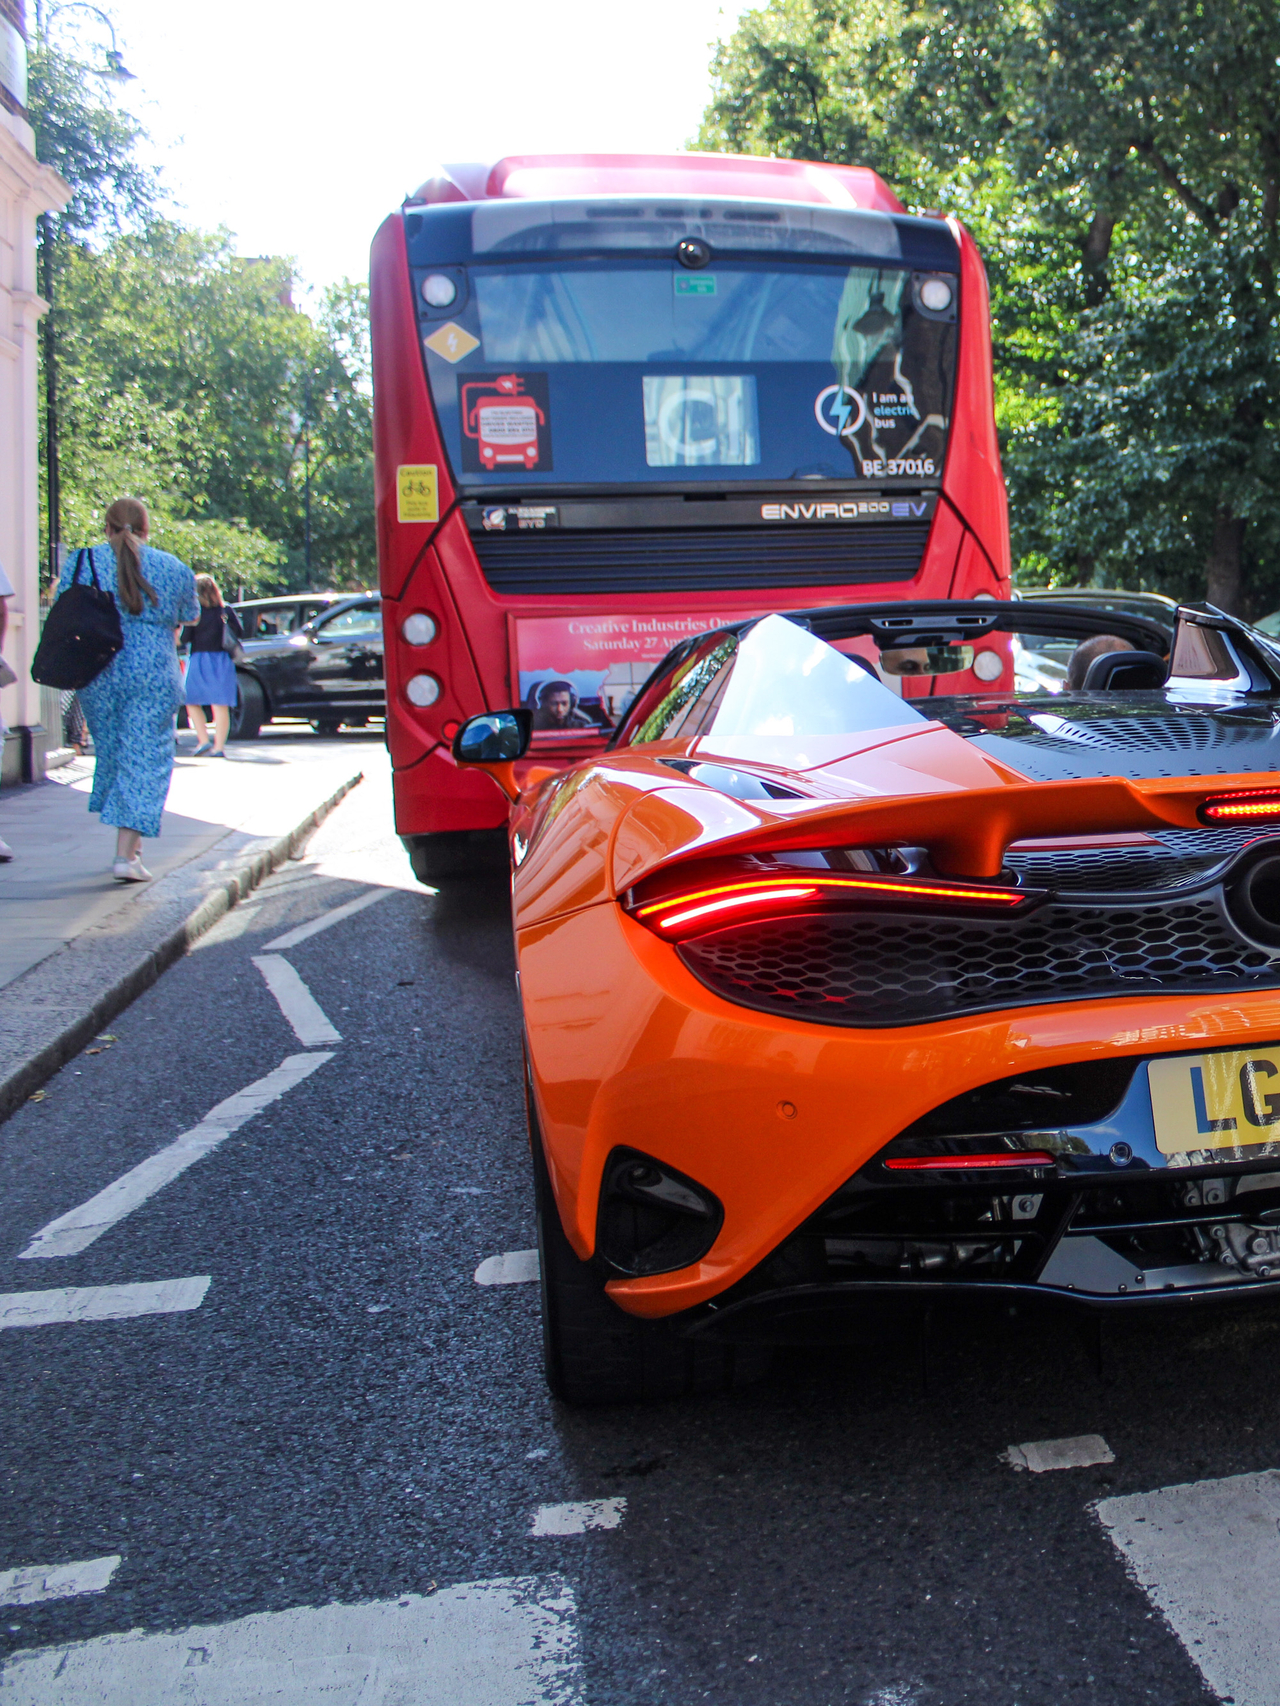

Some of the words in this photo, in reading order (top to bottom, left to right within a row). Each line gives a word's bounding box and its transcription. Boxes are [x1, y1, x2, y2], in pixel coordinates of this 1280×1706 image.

[880, 393, 898, 403] am
[874, 418, 896, 429] bus
[863, 460, 884, 476] BE
[887, 458, 934, 475] 37016
[891, 502, 927, 517] EV
[568, 620, 629, 634] Creative
[632, 617, 707, 633] Industries
[583, 637, 641, 652] Saturday
[644, 637, 657, 648] 27
